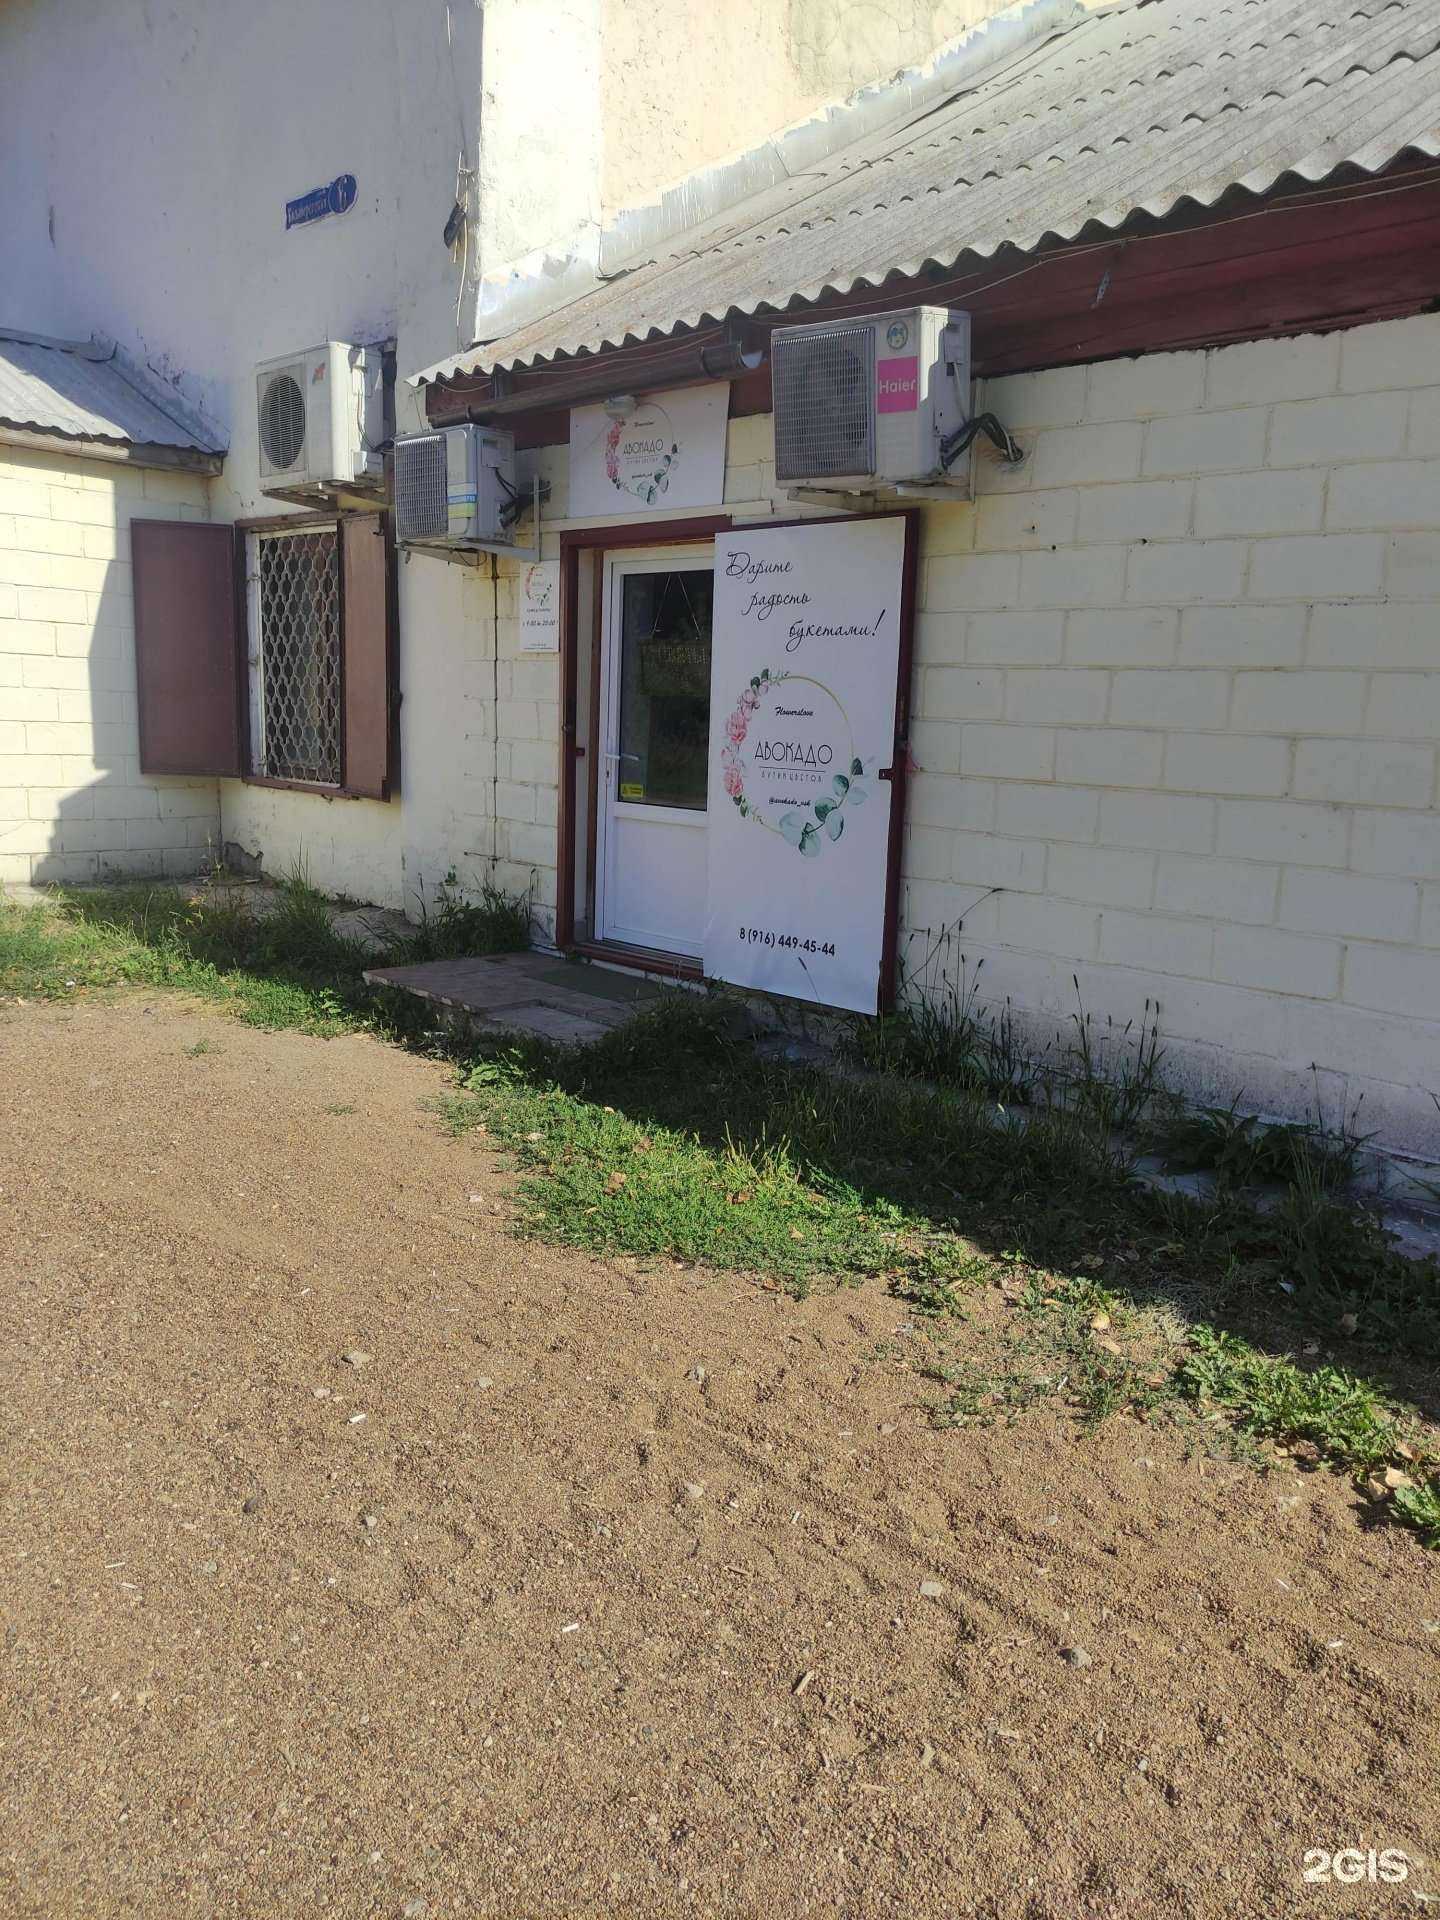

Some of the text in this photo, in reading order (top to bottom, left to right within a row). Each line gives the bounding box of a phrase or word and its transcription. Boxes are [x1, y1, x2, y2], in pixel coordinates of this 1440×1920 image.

[879, 379, 917, 394] Haier
[623, 438, 664, 455] АВОКАДО
[725, 552, 793, 584] Дарите
[741, 591, 812, 621] радость
[785, 608, 886, 652] букетами!
[754, 741, 833, 767] АВОКАДО
[739, 927, 836, 957] 8 (916) 449-45-44
